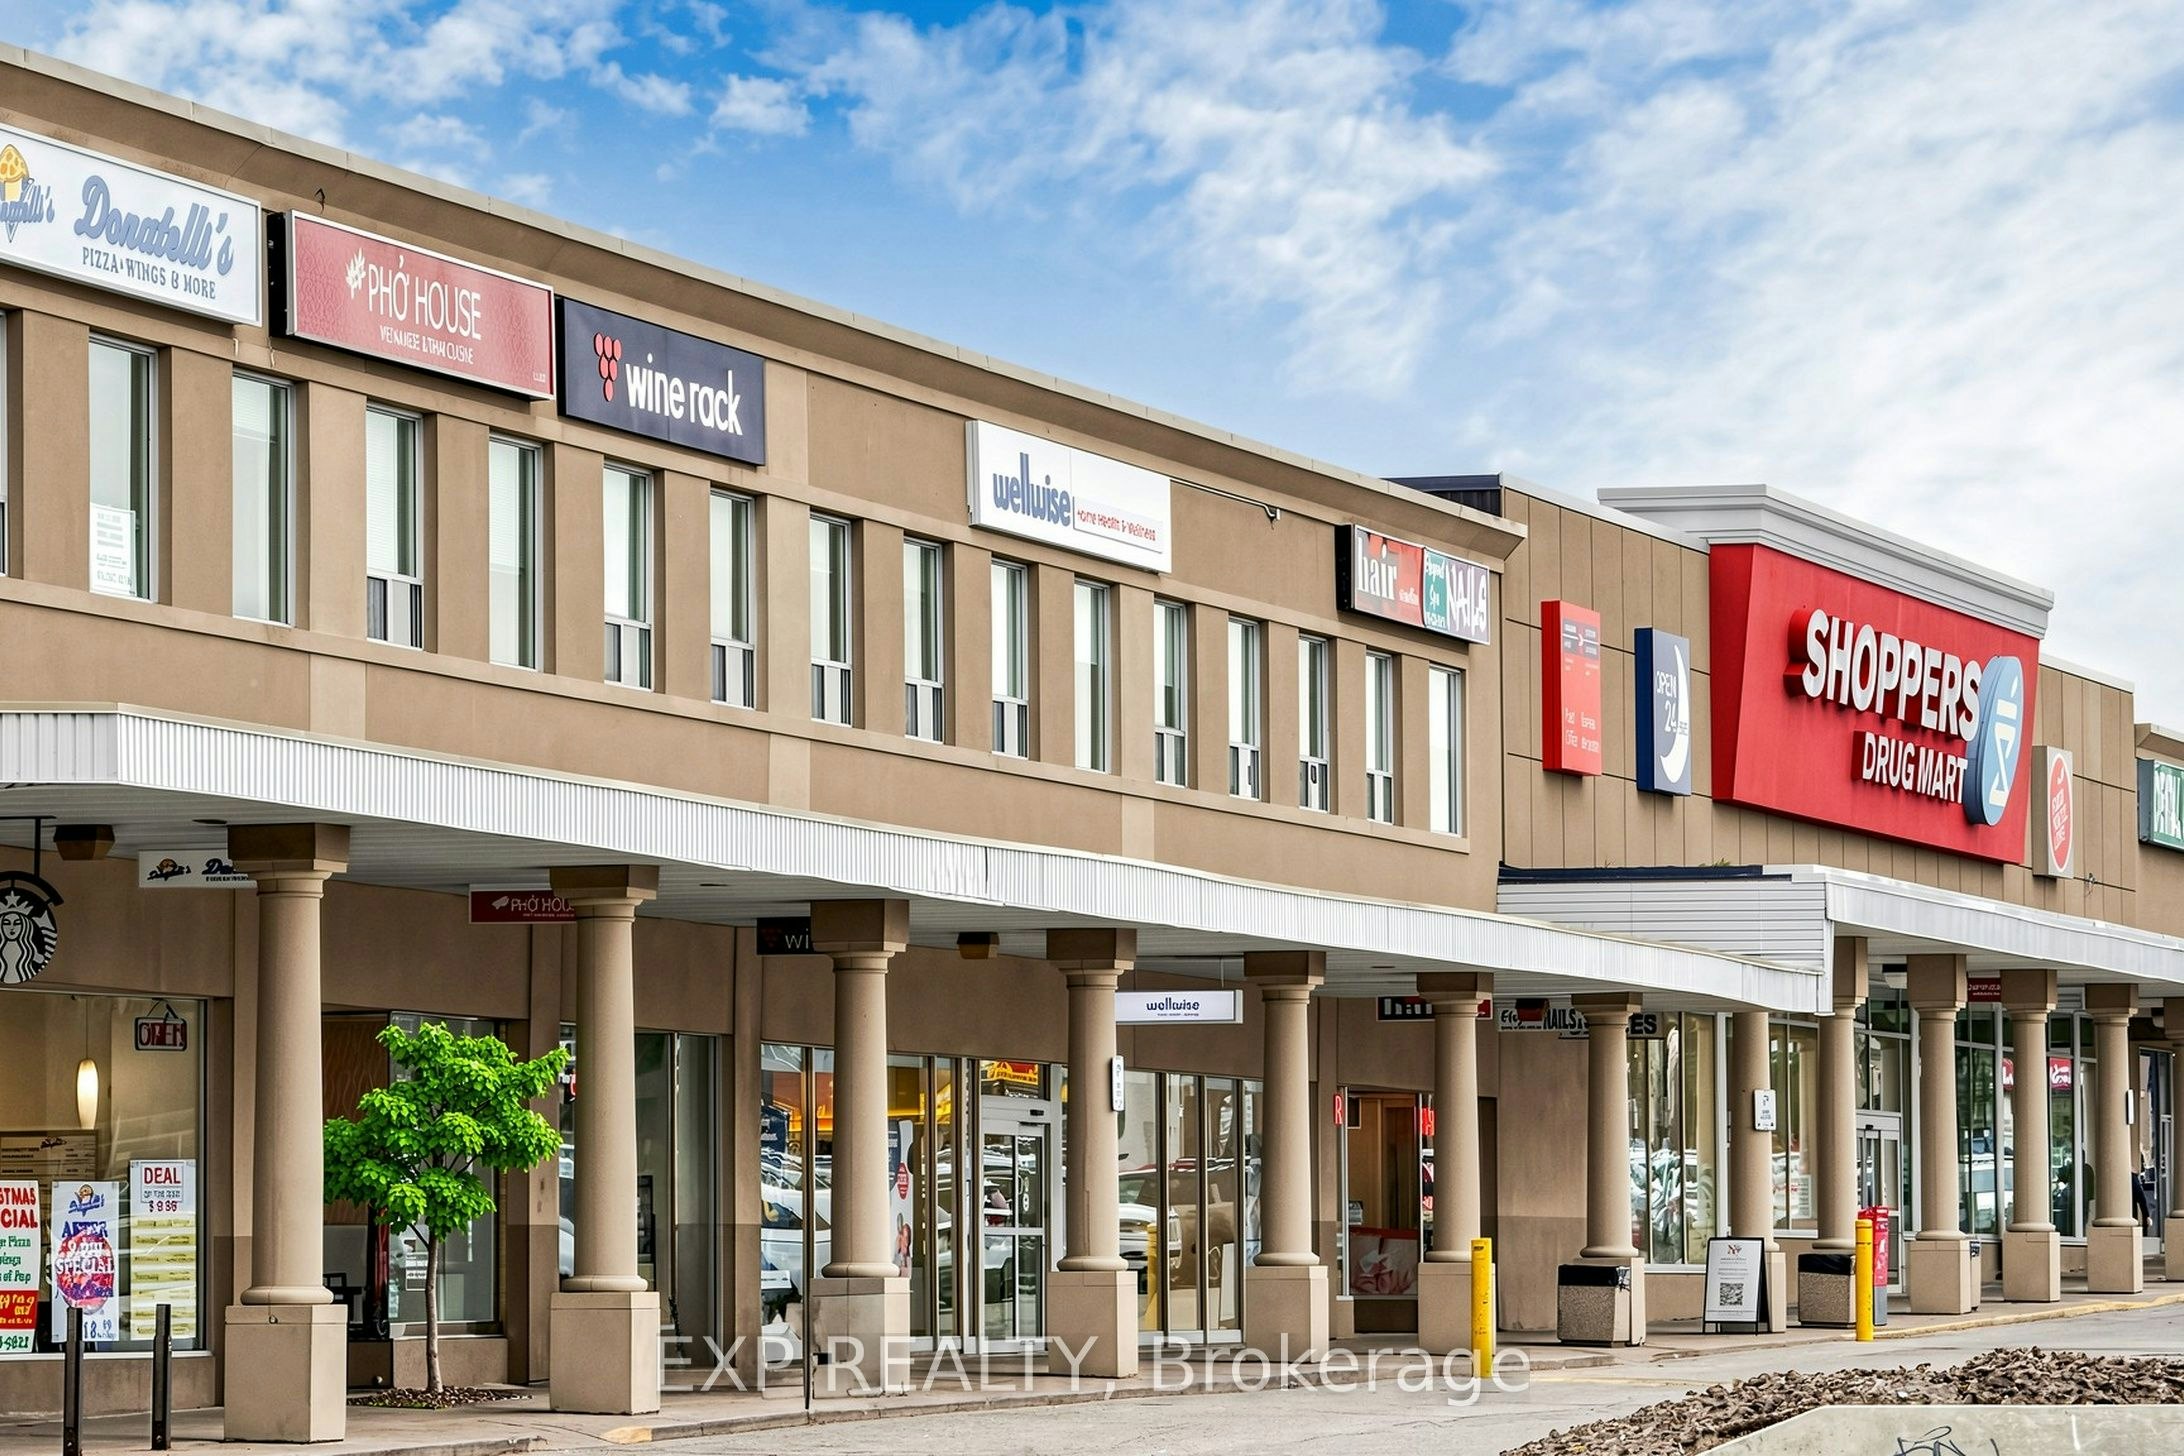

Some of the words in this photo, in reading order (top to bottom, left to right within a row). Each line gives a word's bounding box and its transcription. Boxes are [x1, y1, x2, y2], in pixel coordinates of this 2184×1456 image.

[74, 175, 234, 276] Donatelli's
[183, 273, 217, 300] MORE
[415, 275, 482, 341] HOUSE
[625, 353, 686, 419] wine
[689, 369, 743, 436] rack
[992, 451, 1071, 528] wellwise
[1358, 536, 1398, 600] hair
[1802, 608, 1984, 742] SHOPPERS
[1862, 731, 1915, 791] DRUG
[1917, 746, 1968, 804] MART
[785, 928, 809, 949] wi
[140, 1022, 186, 1047] OPEN
[144, 1167, 182, 1184] DEAL
